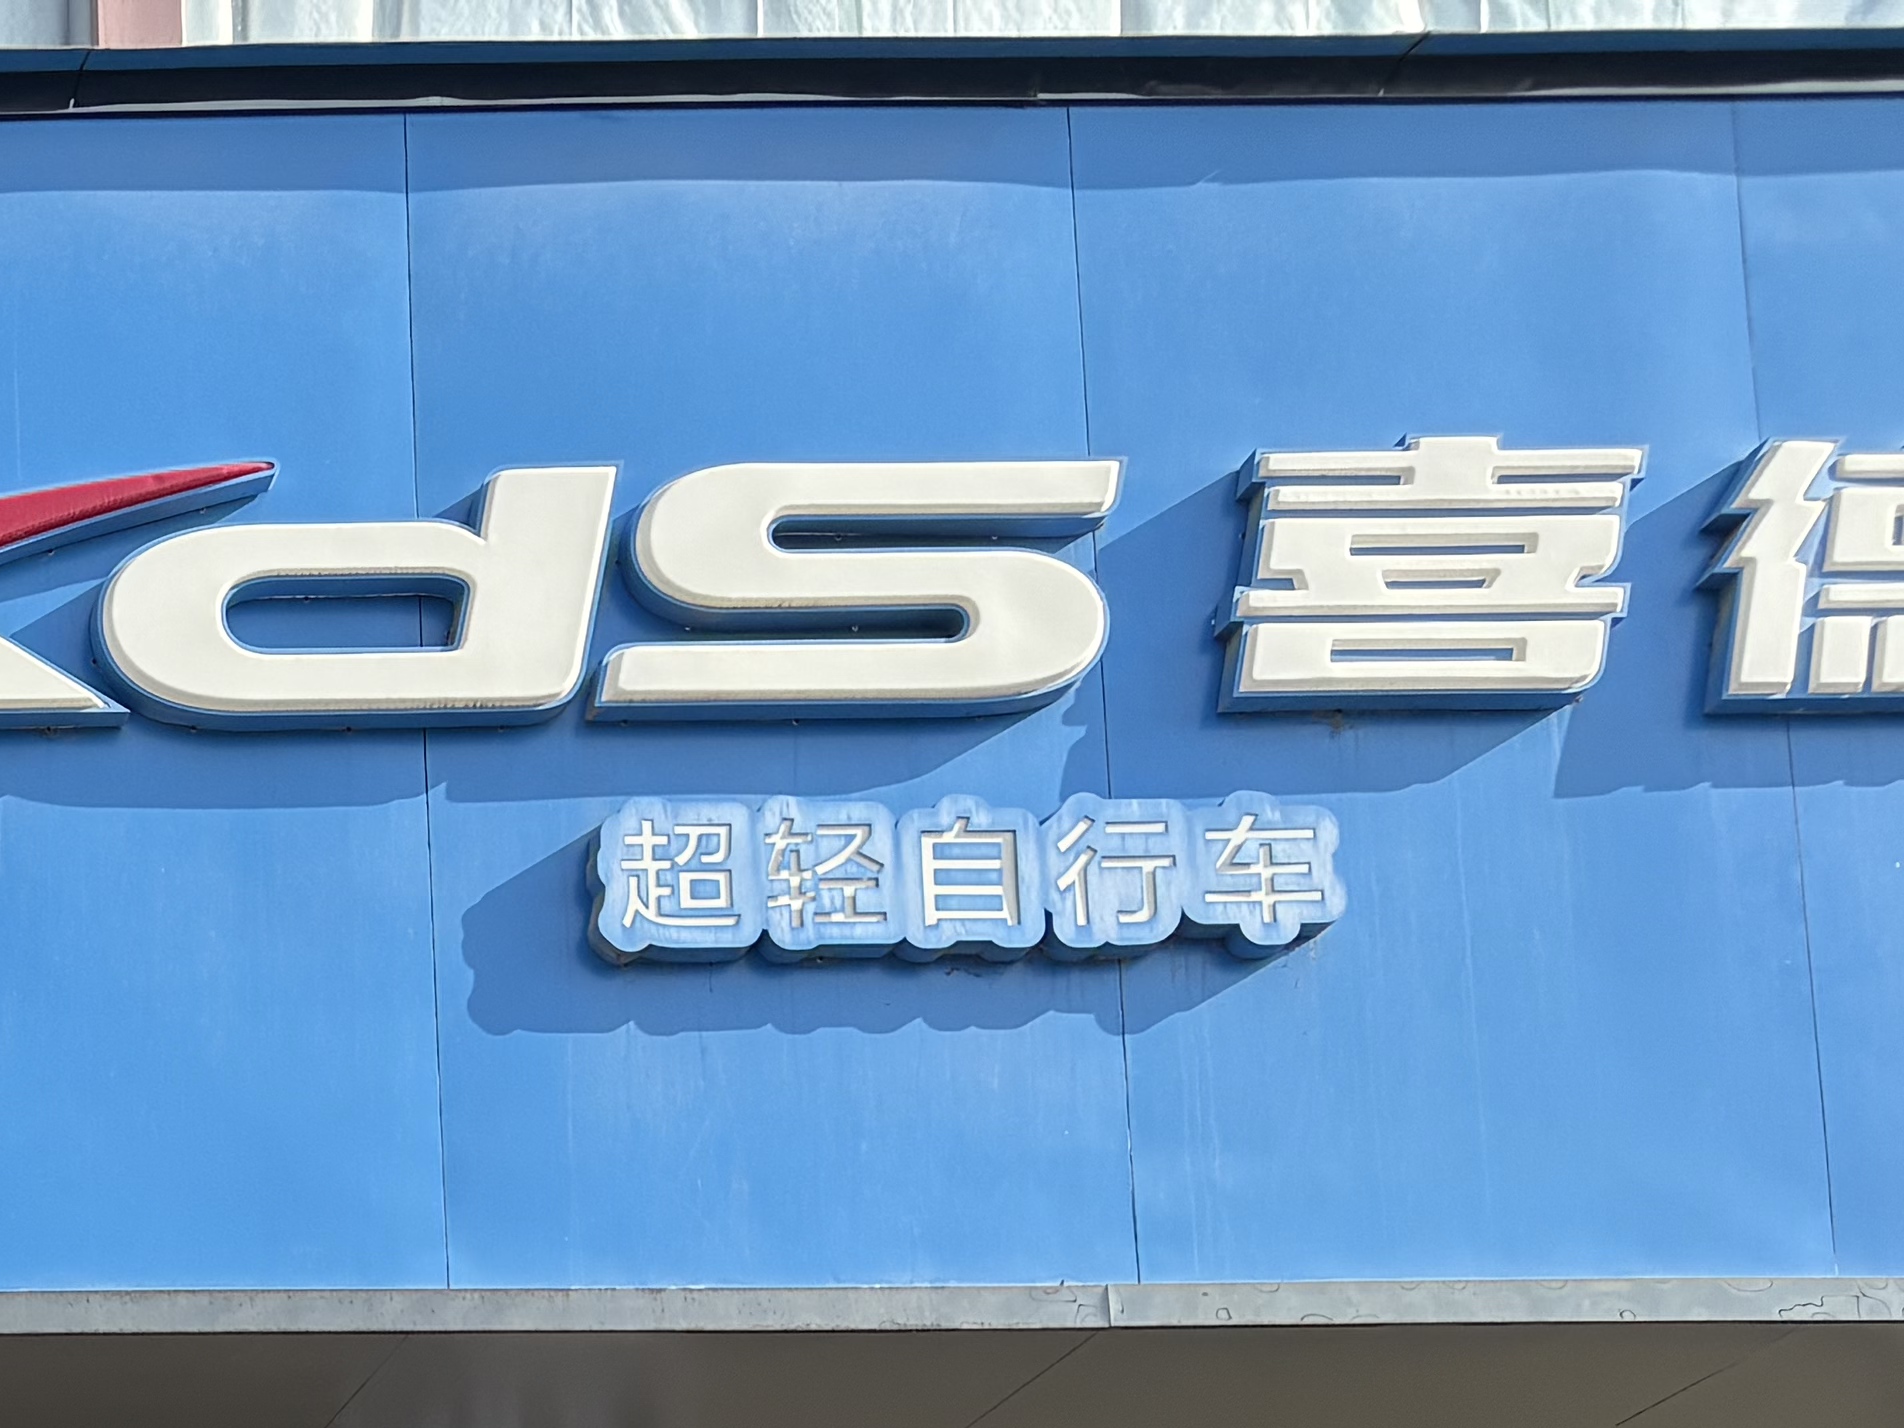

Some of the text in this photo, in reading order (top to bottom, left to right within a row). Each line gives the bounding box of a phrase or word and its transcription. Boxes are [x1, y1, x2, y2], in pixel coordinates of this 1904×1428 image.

[612, 800, 1337, 940] 超轻自行车
